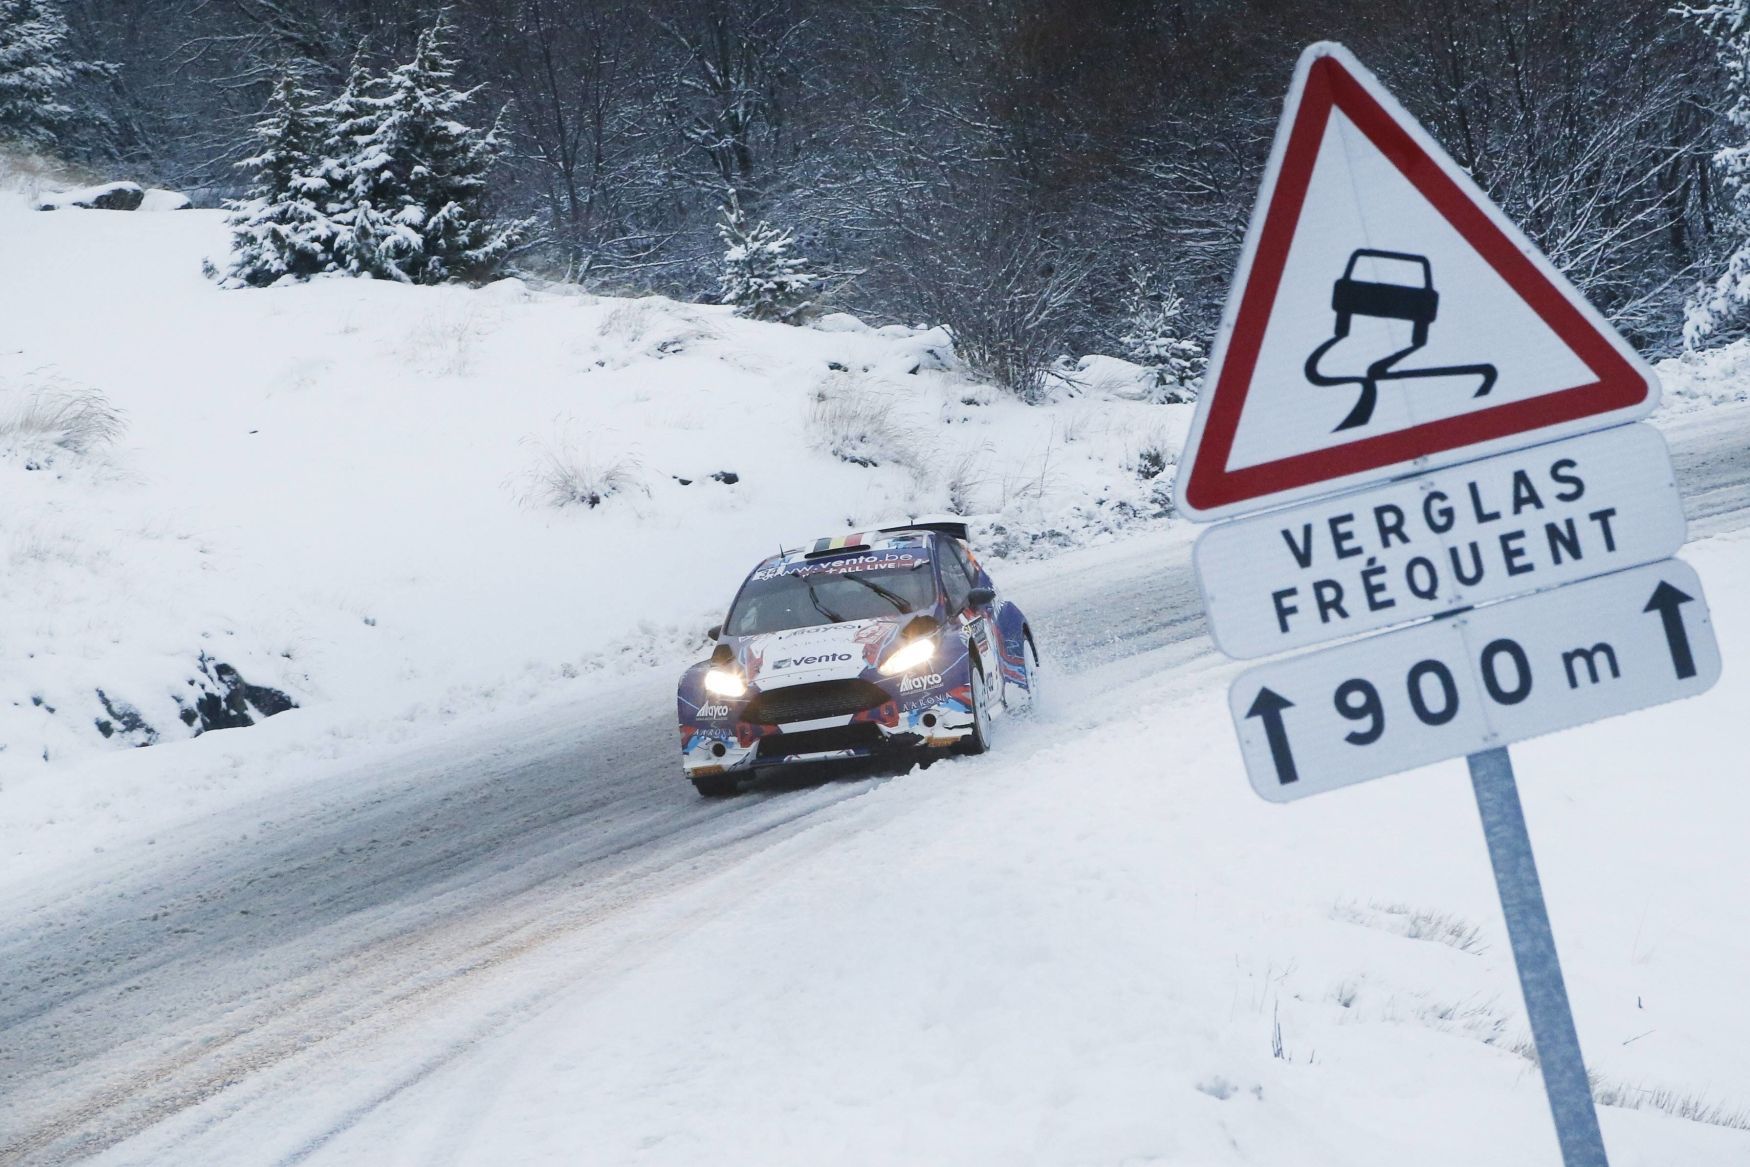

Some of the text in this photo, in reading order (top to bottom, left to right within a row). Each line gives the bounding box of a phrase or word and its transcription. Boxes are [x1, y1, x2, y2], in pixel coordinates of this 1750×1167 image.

[866, 562, 896, 571] LIVE
[1281, 459, 1585, 568] VERGLAS
[1272, 508, 1617, 633] FRÉQUENT
[792, 652, 852, 667] vento
[1334, 638, 1620, 746] 900 m
